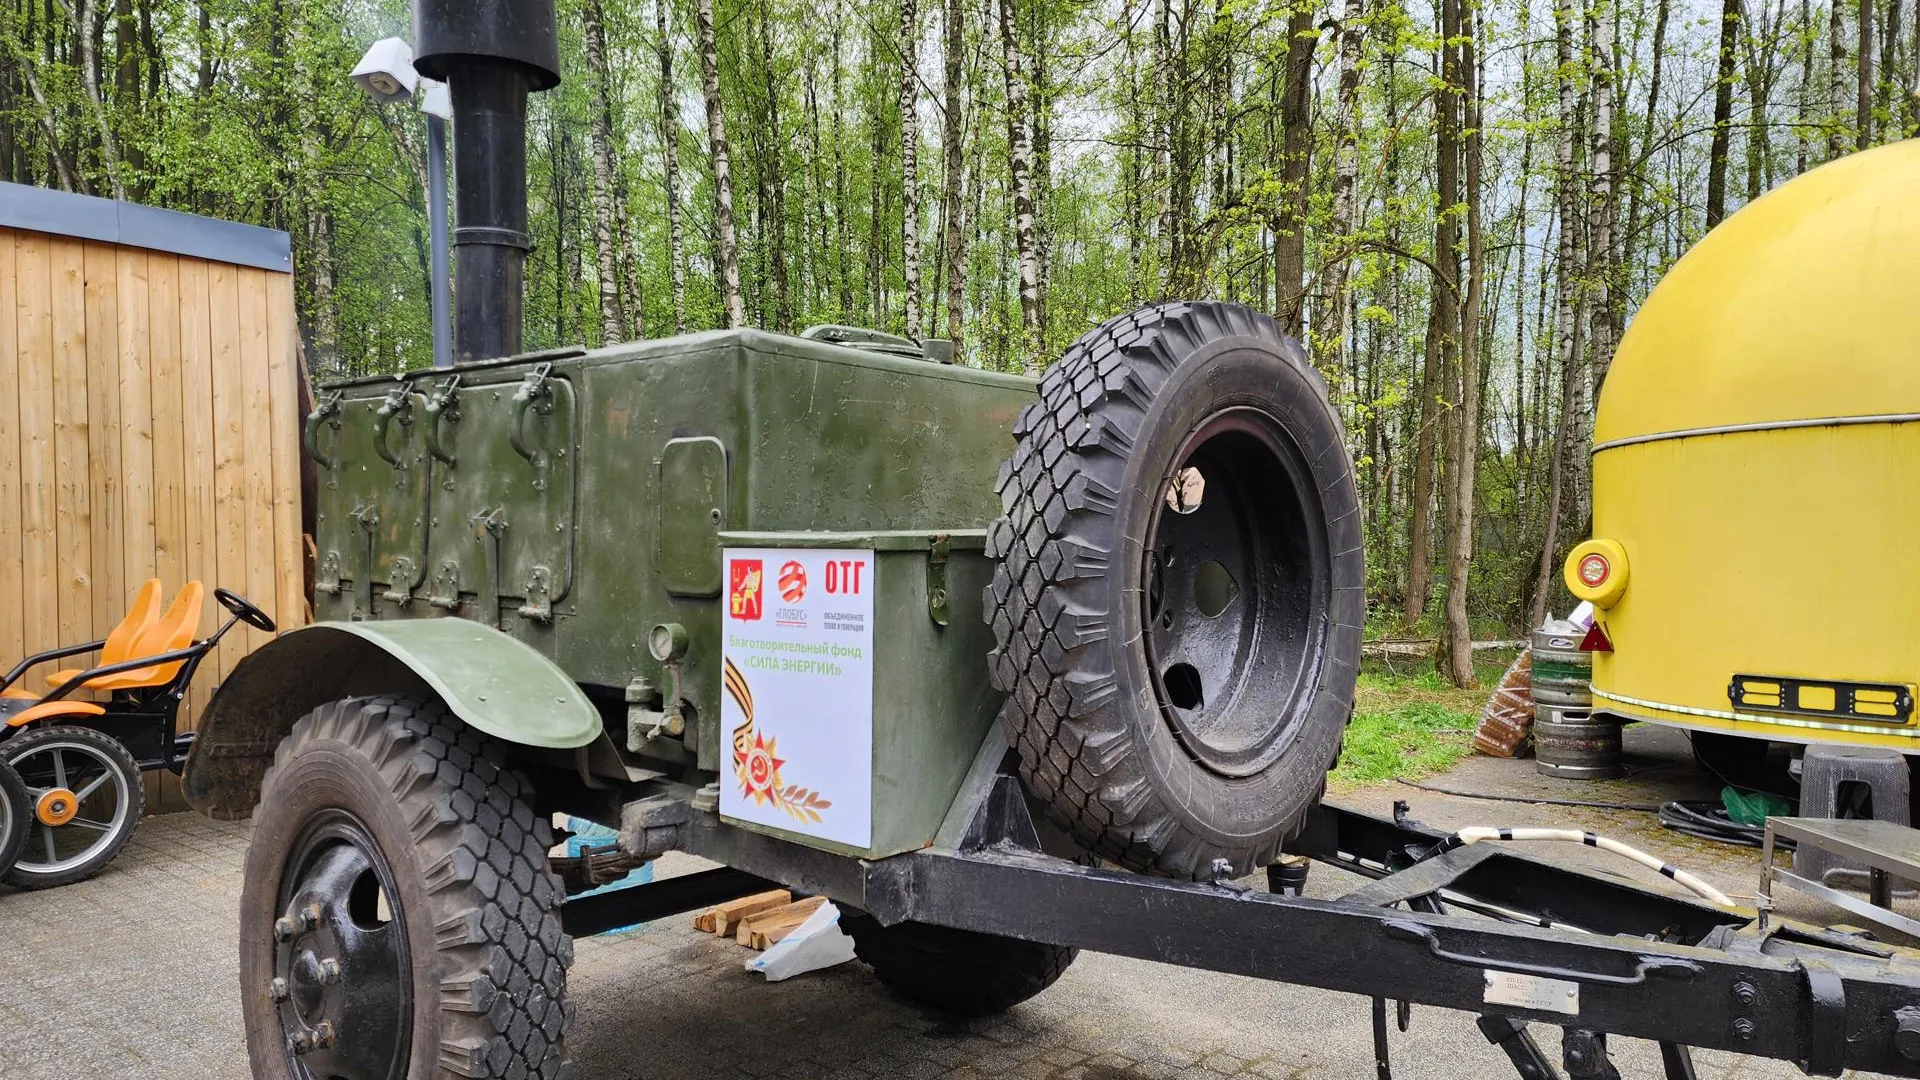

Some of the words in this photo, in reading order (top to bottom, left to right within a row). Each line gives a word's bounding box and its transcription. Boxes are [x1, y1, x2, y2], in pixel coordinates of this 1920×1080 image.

[825, 560, 865, 594] ОТГ
[729, 634, 829, 655] Благотворительный
[831, 641, 863, 660] фонд
[743, 655, 780, 670] «СИЛА
[782, 658, 842, 677] ЭНЕРГИИ»
